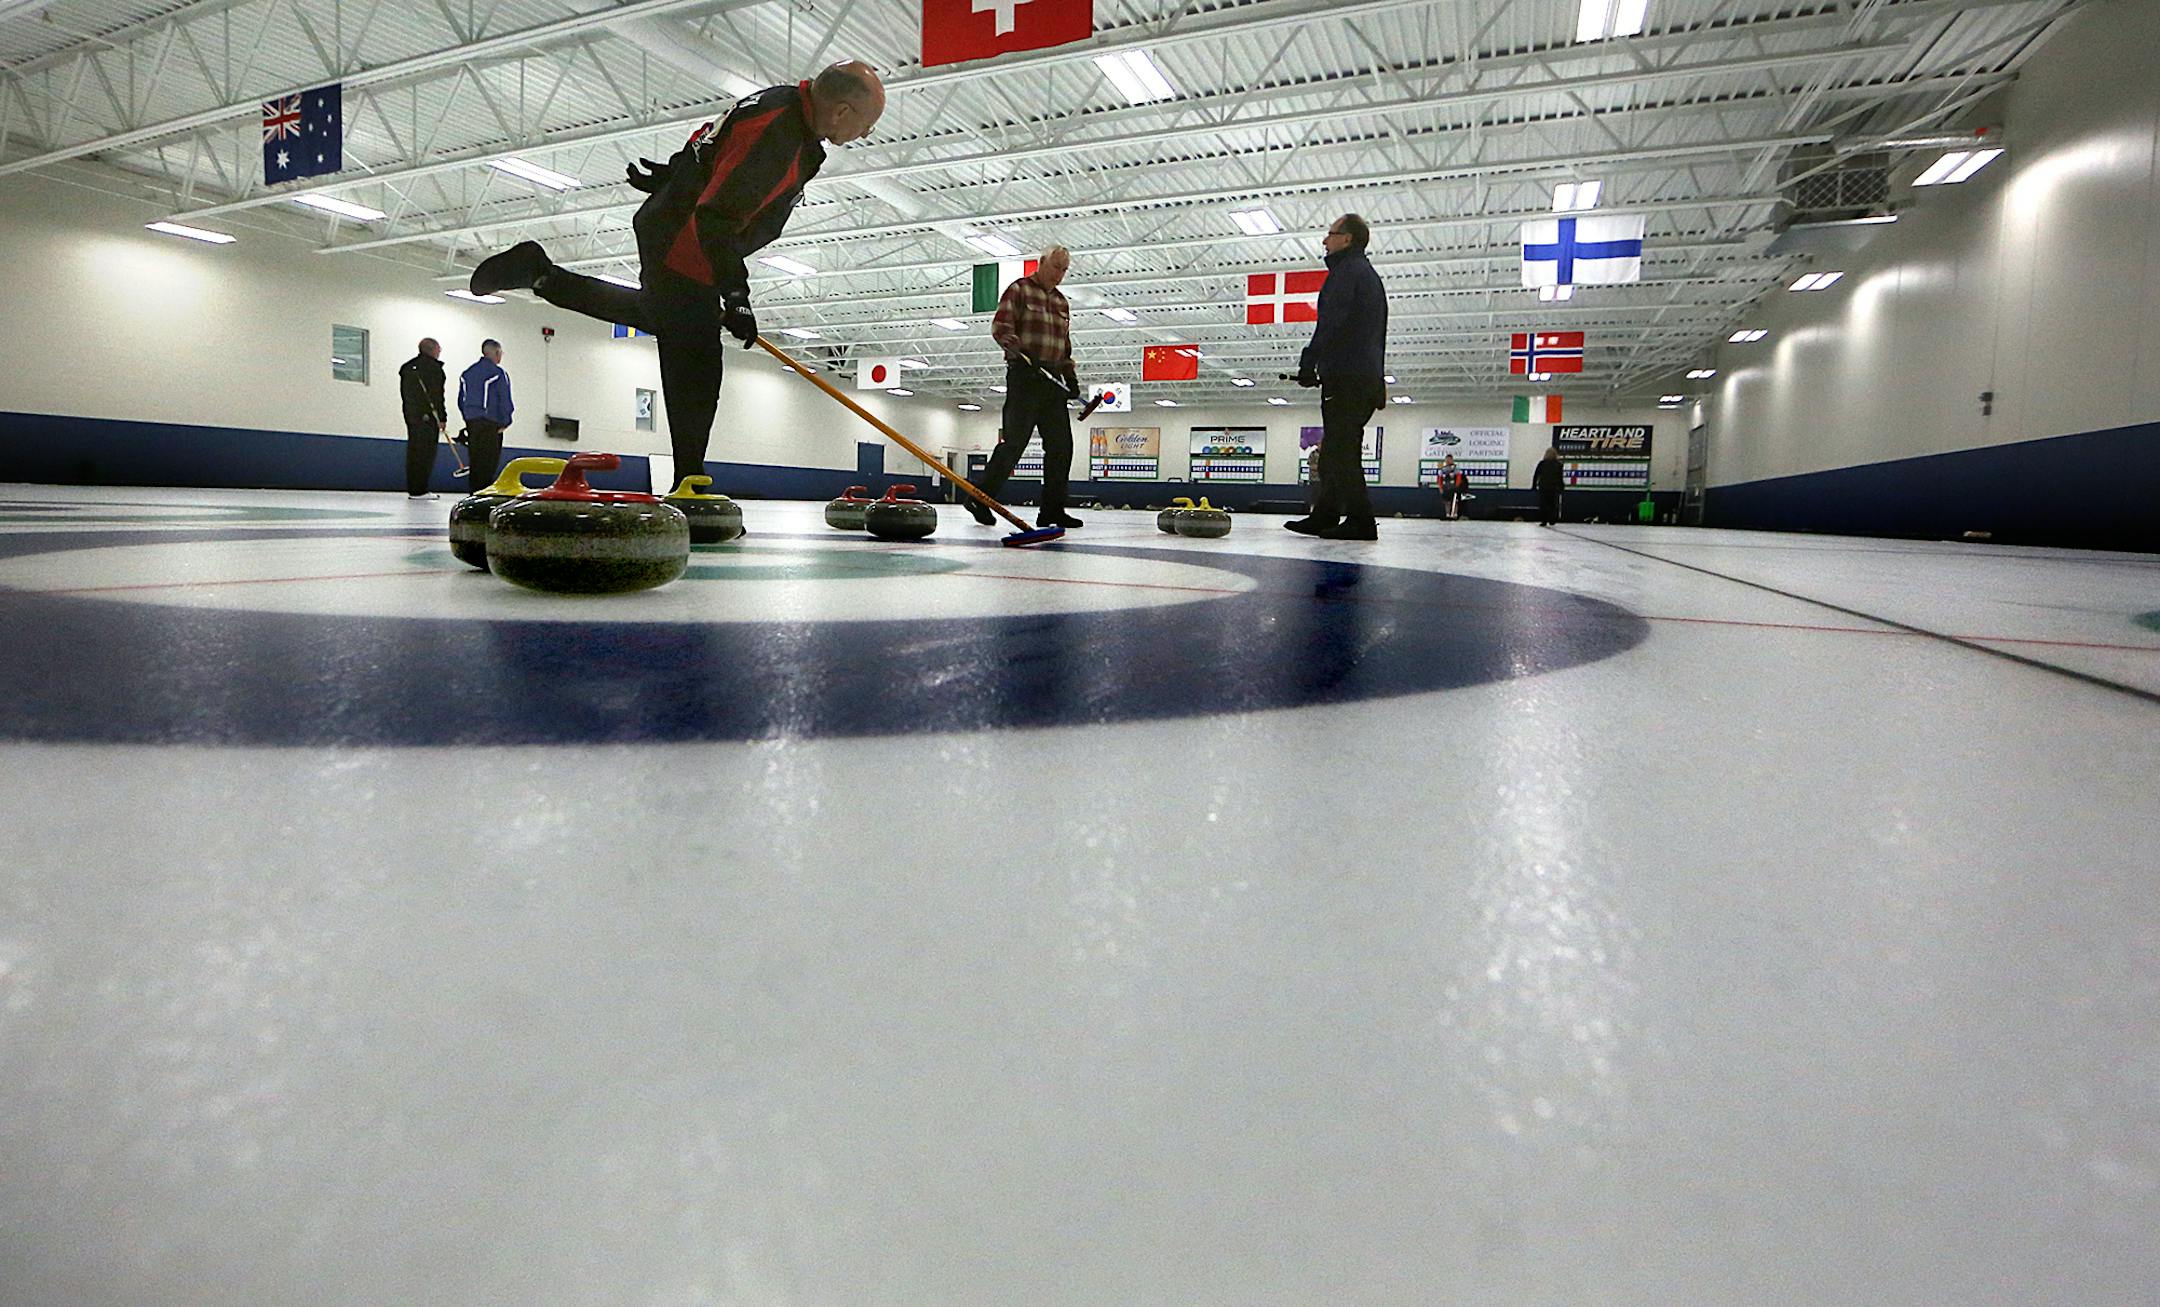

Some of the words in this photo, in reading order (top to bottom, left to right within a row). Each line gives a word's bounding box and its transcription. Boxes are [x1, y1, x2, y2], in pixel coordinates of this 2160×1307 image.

[1560, 427, 1645, 438] HEARTLAND
[1115, 433, 1148, 443] Golden
[1210, 435, 1246, 443] PRIME
[1590, 437, 1645, 448] TIRE
